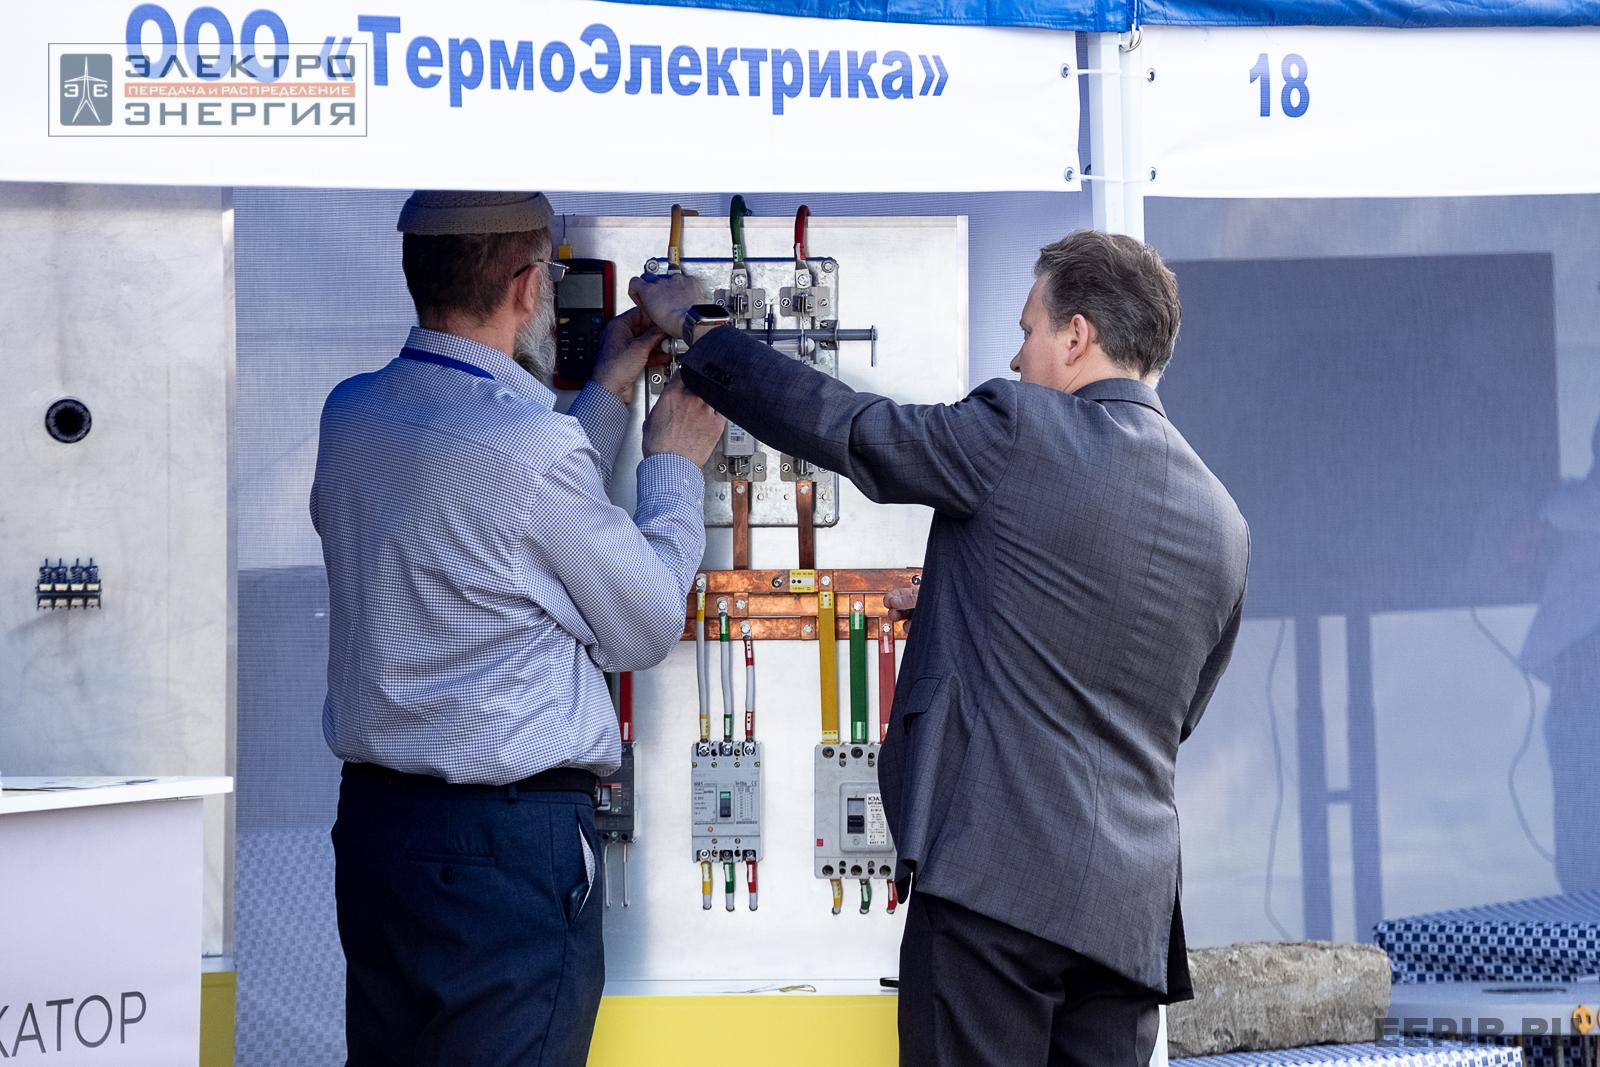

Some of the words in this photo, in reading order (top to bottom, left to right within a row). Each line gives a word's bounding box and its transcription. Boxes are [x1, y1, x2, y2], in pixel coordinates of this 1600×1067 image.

[125, 3, 290, 83] ООО
[320, 14, 949, 116] «ТермоЭлектрика»
[1249, 53, 1310, 118] 18
